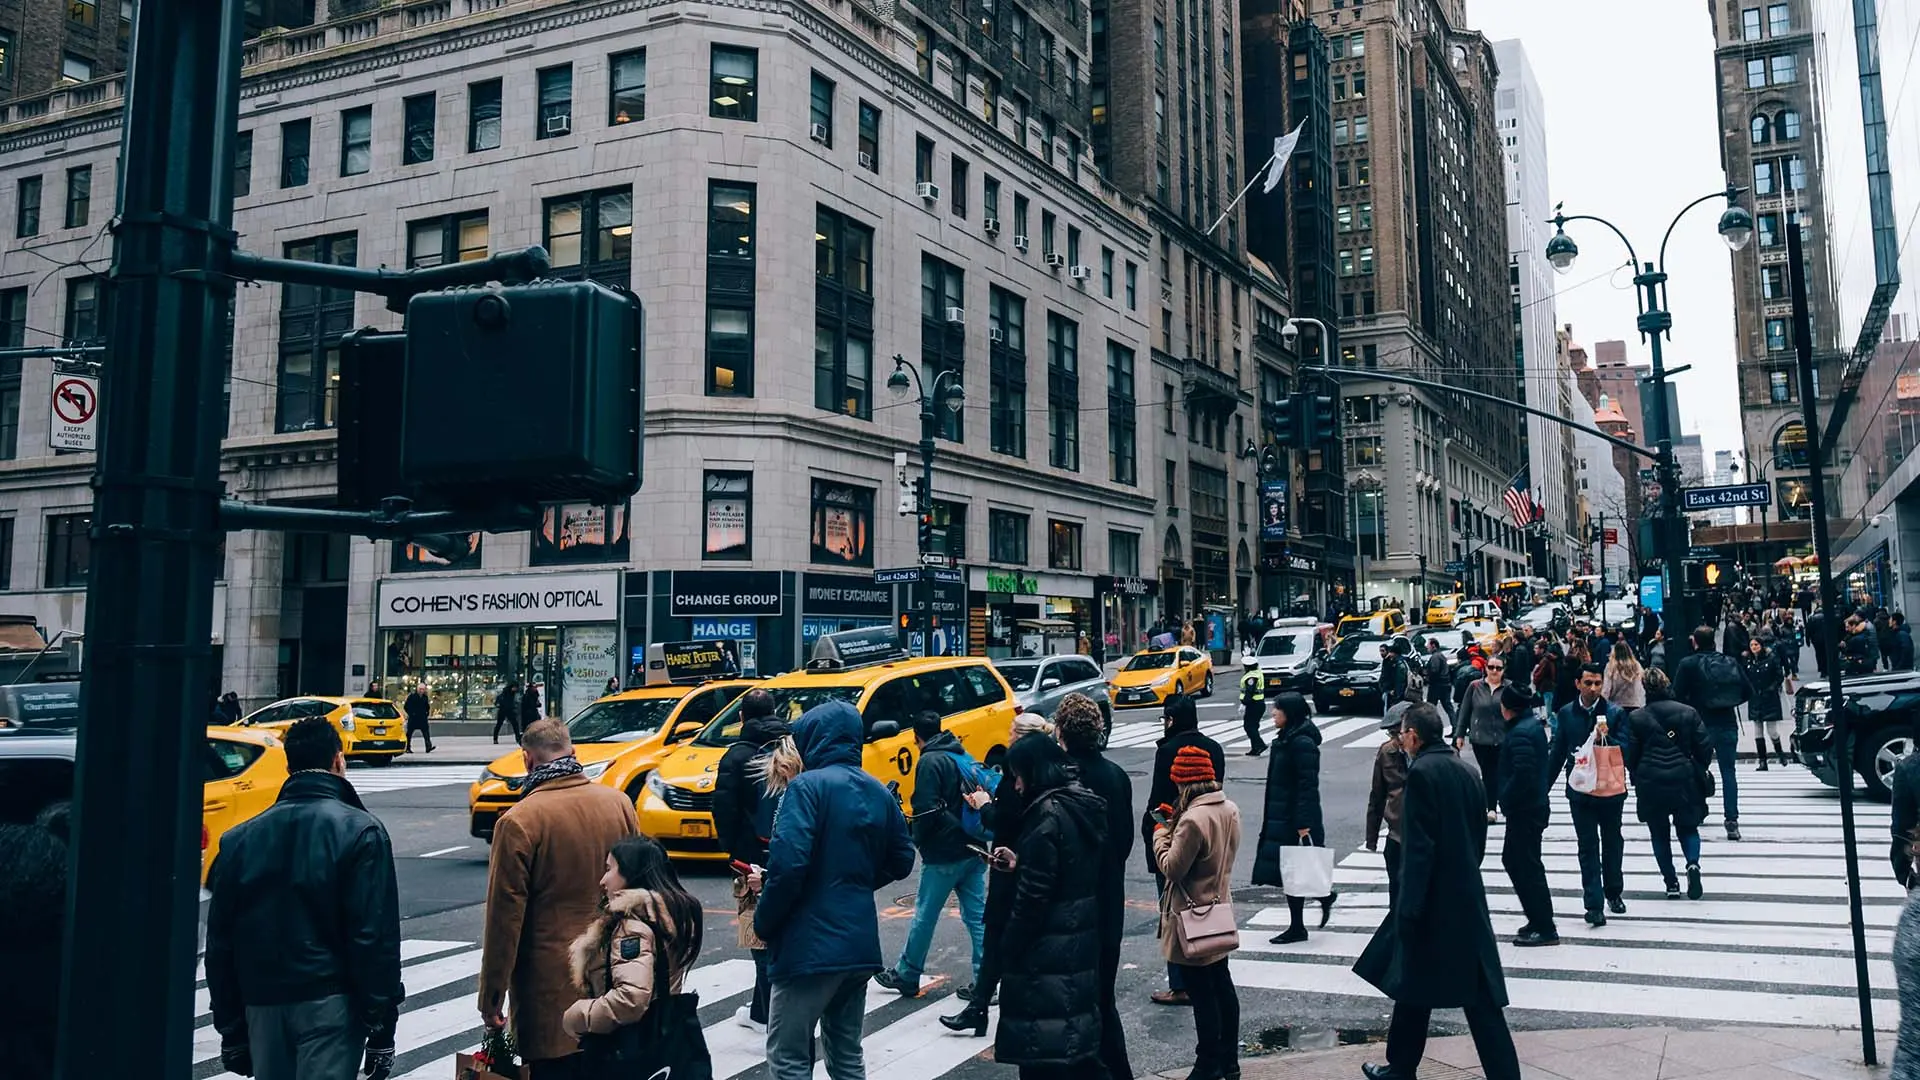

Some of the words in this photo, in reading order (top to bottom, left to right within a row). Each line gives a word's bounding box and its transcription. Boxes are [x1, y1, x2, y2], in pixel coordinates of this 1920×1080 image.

[57, 432, 91, 440] AUTHORIZED
[63, 425, 84, 433] EXCEPT
[1689, 493, 1716, 505] East
[1718, 490, 1748, 502] 42nd
[1751, 489, 1765, 500] St
[893, 572, 908, 580] 42nd
[910, 571, 917, 579] St
[390, 594, 479, 613] COHEN'S
[482, 592, 539, 610] FASHION
[544, 590, 603, 609] OPTICAL
[675, 594, 730, 606] CHANGE
[733, 594, 778, 606] GROUP
[809, 587, 842, 600] MONEY
[843, 589, 888, 602] EXCHANGE
[693, 623, 752, 636] HANGE
[665, 652, 691, 666] HARRY
[692, 651, 722, 664] POTTER
[900, 751, 909, 772] T
